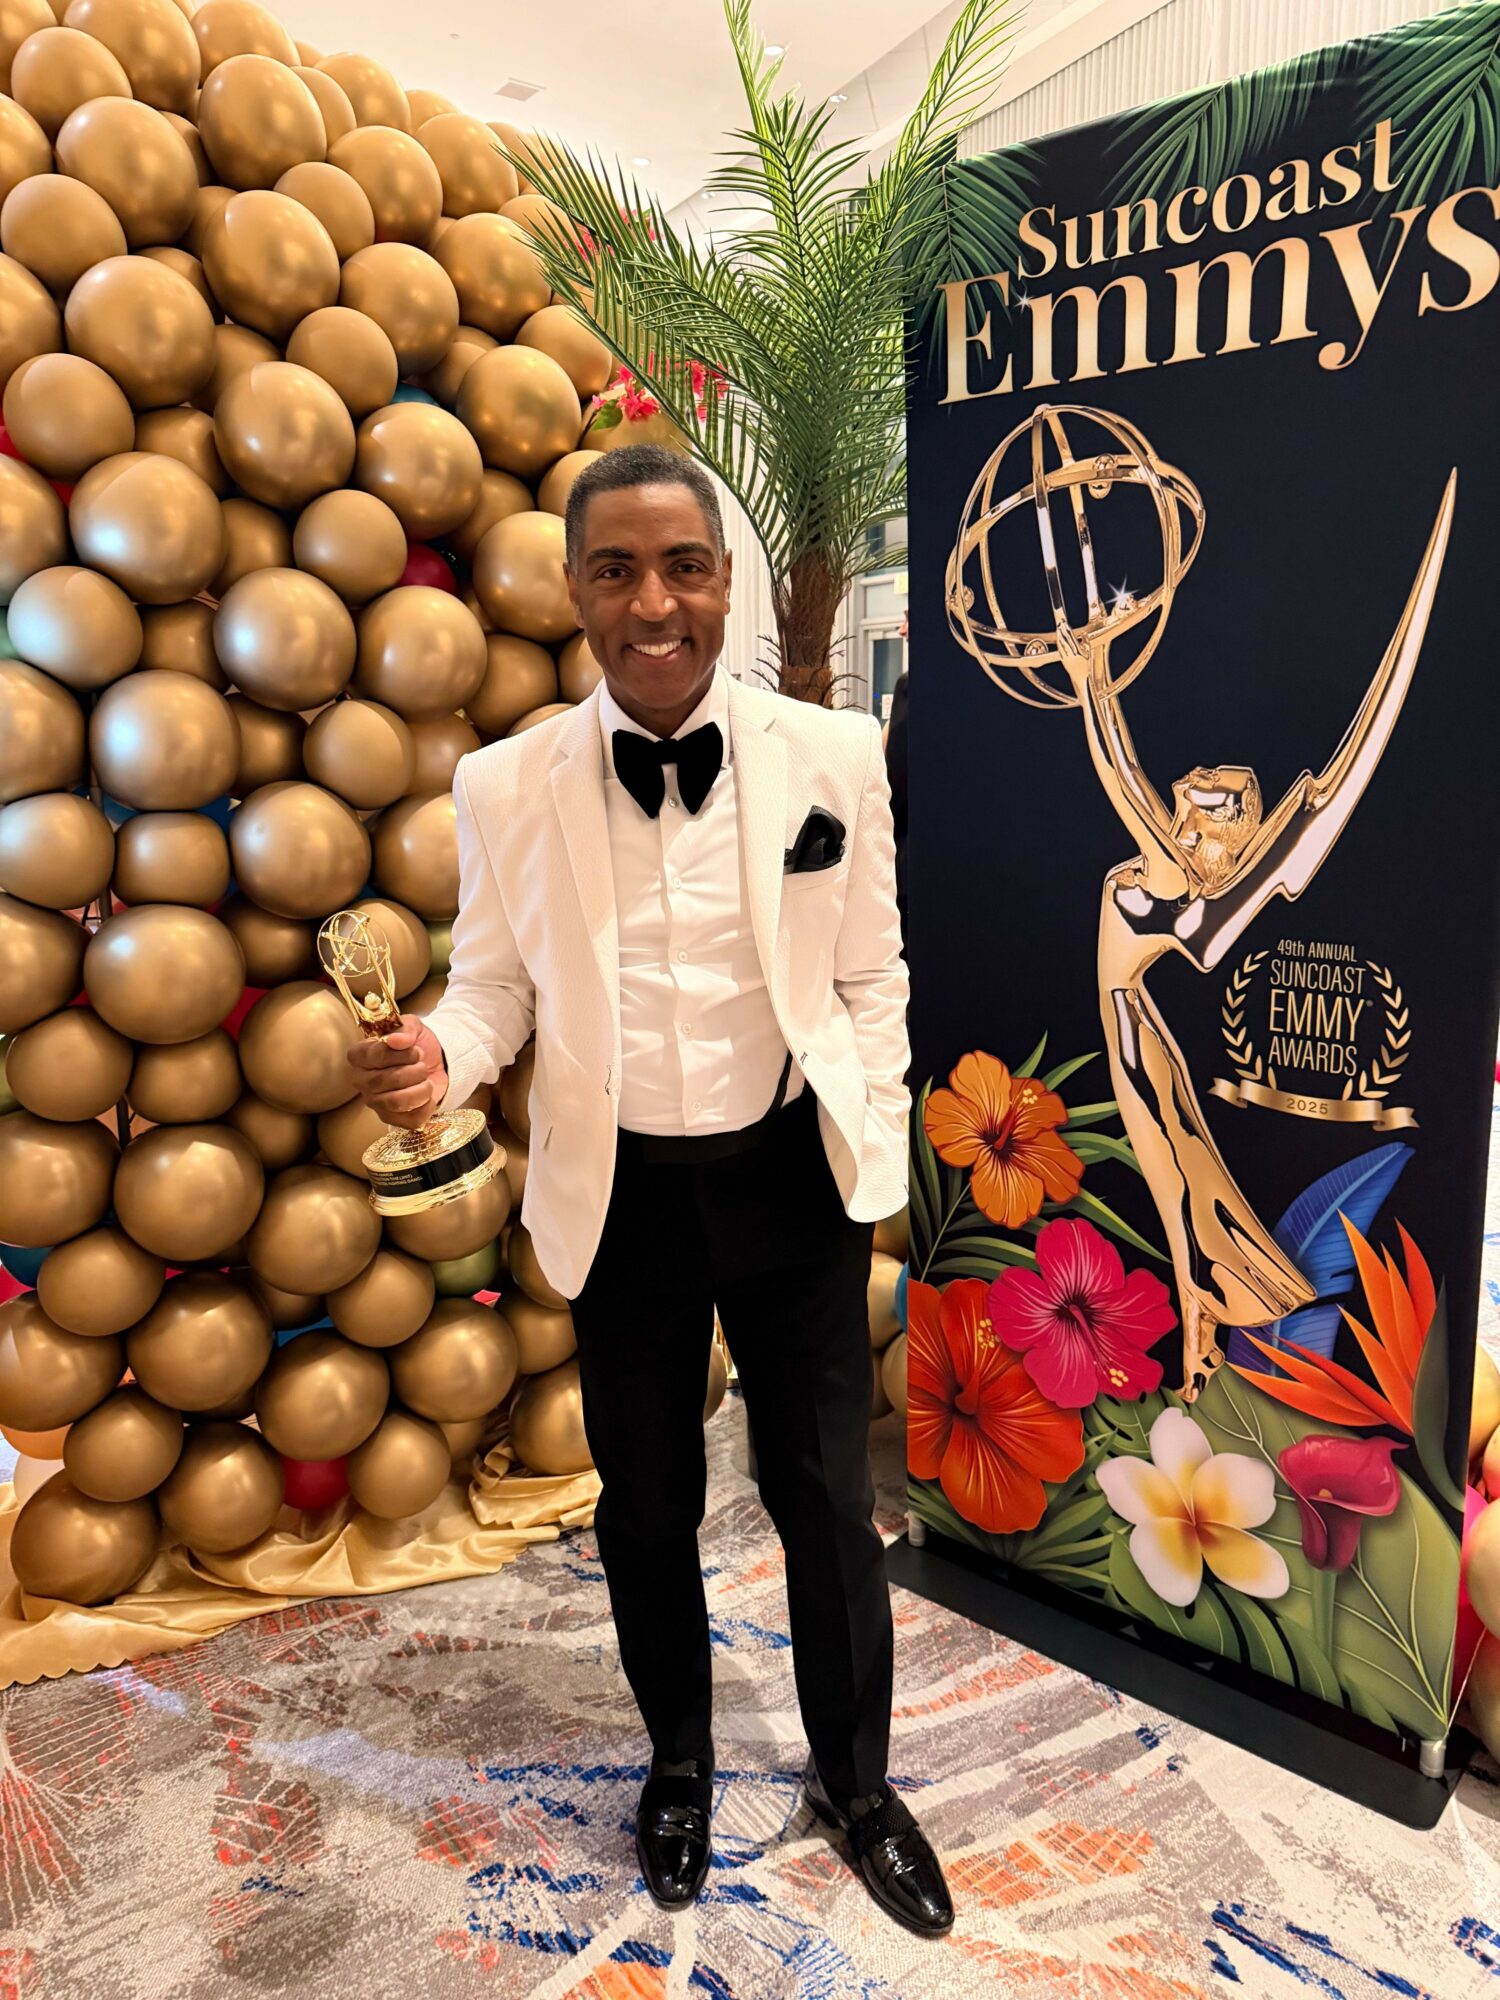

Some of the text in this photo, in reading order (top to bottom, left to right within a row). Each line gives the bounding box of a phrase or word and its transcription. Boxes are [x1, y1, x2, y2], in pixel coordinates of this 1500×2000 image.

[1017, 118, 1406, 280] Suncoast
[937, 185, 1500, 404] Emmys
[1277, 939, 1357, 962] 49th ANNUAL
[1270, 959, 1366, 994] SUNCOAST
[1268, 1036, 1357, 1077] AWARDS
[1286, 1098, 1329, 1115] 2025
